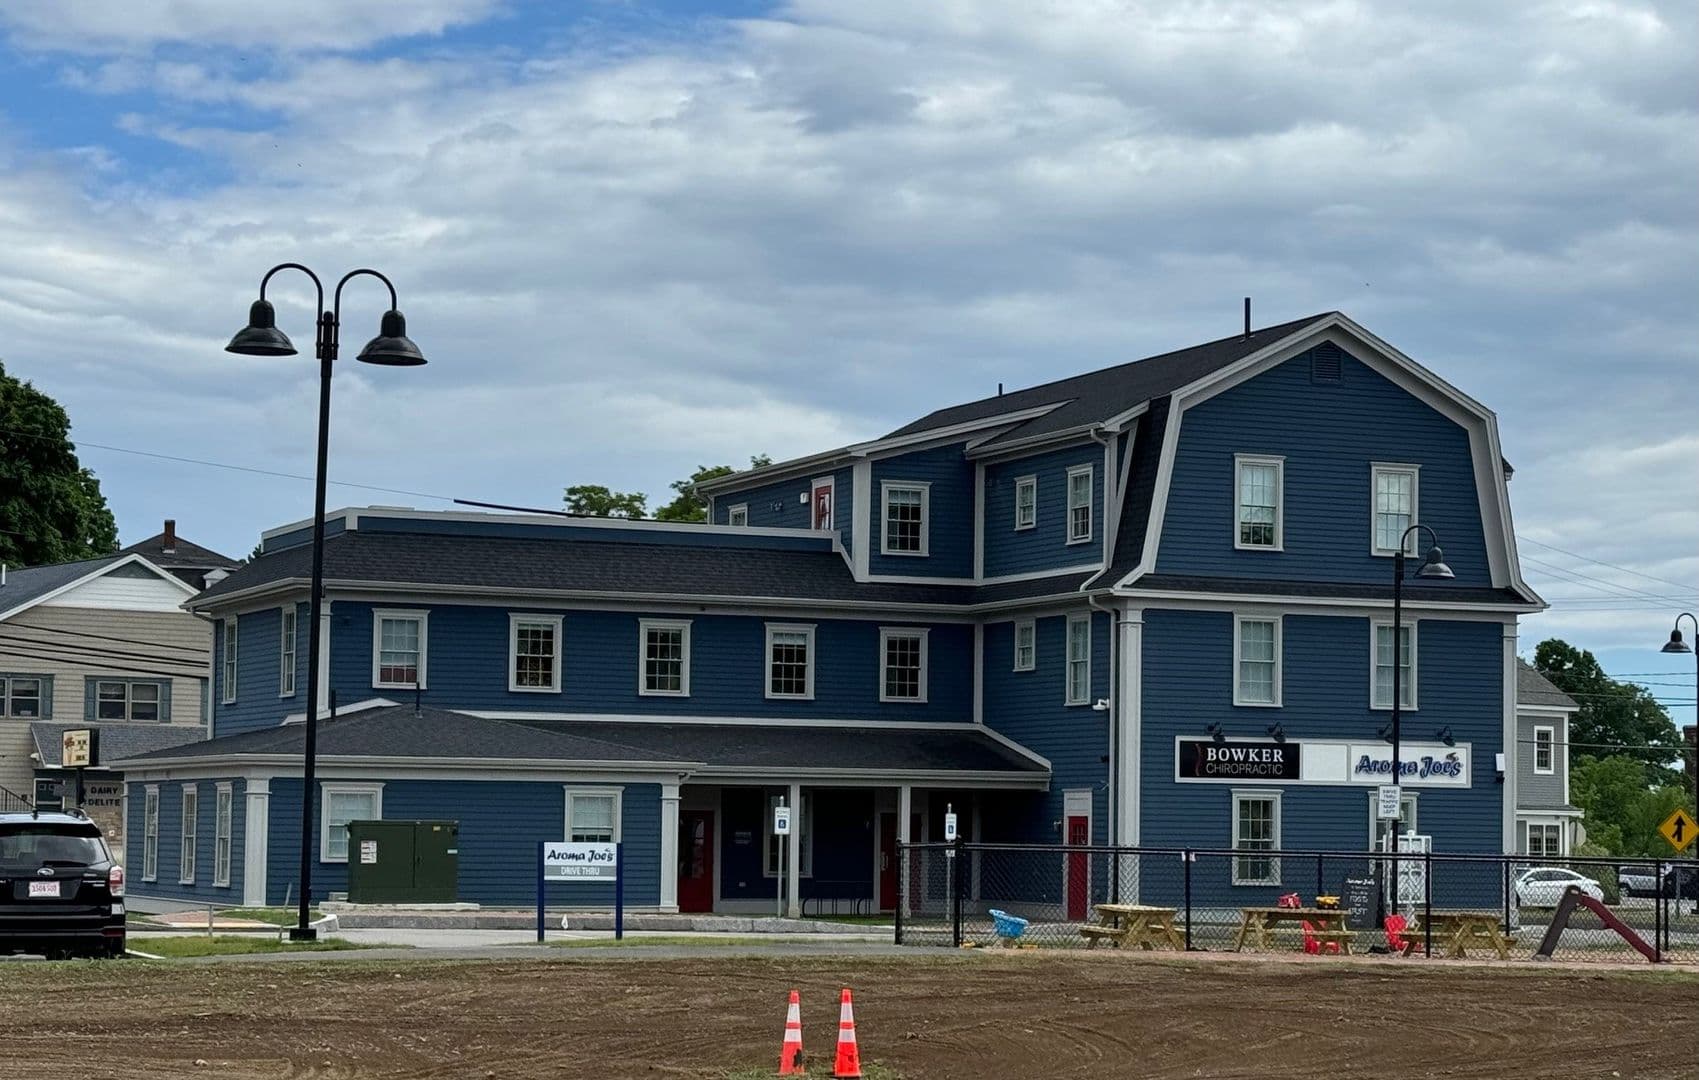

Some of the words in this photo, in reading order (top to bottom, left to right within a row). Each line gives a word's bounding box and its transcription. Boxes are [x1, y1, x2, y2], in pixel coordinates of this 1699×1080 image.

[1206, 747, 1284, 762] BOWKER
[1206, 763, 1283, 775] CHIROPRACTIC
[90, 786, 118, 794] DAIRY
[89, 798, 120, 807] DELITE
[547, 849, 585, 861] Aroma
[561, 866, 581, 876] DRIVE
[582, 866, 600, 876] THRU
